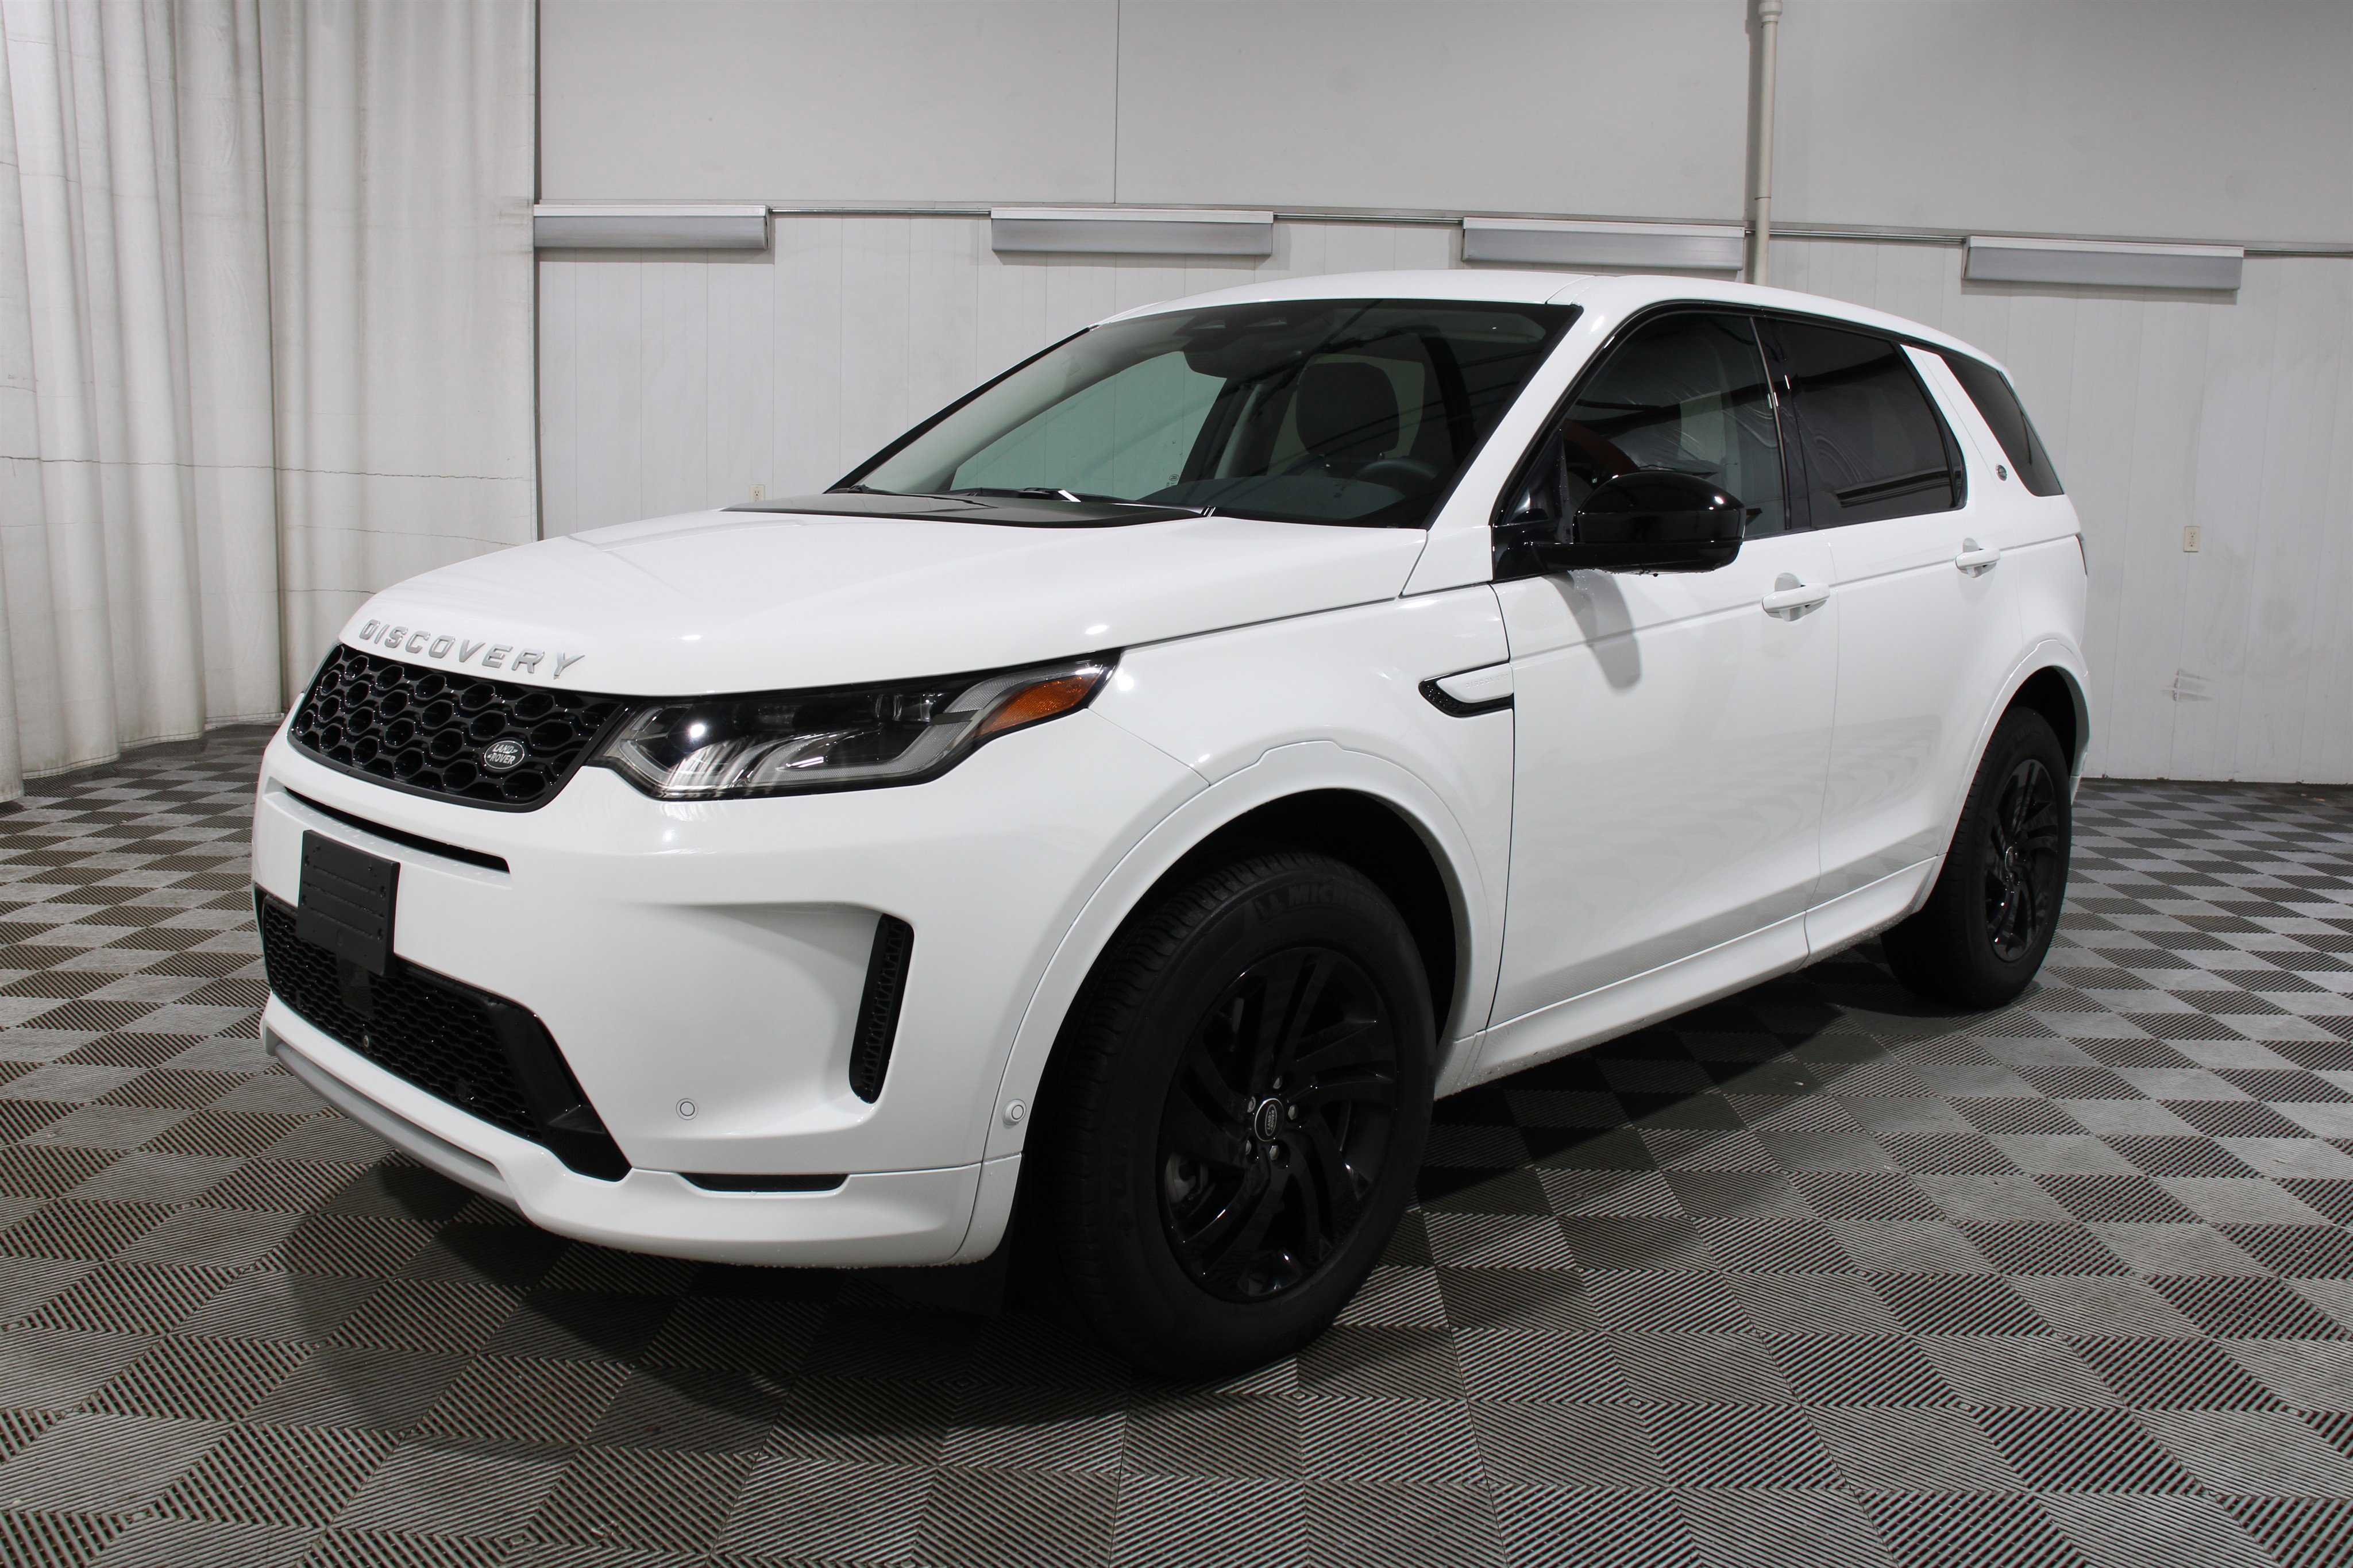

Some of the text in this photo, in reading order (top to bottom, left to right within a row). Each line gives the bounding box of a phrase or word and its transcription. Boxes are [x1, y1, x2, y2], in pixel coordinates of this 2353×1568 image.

[359, 619, 585, 677] DISCOVERY
[1465, 673, 1510, 689] DISCOVERY
[492, 744, 514, 754] LAND
[489, 752, 516, 764] ROVER
